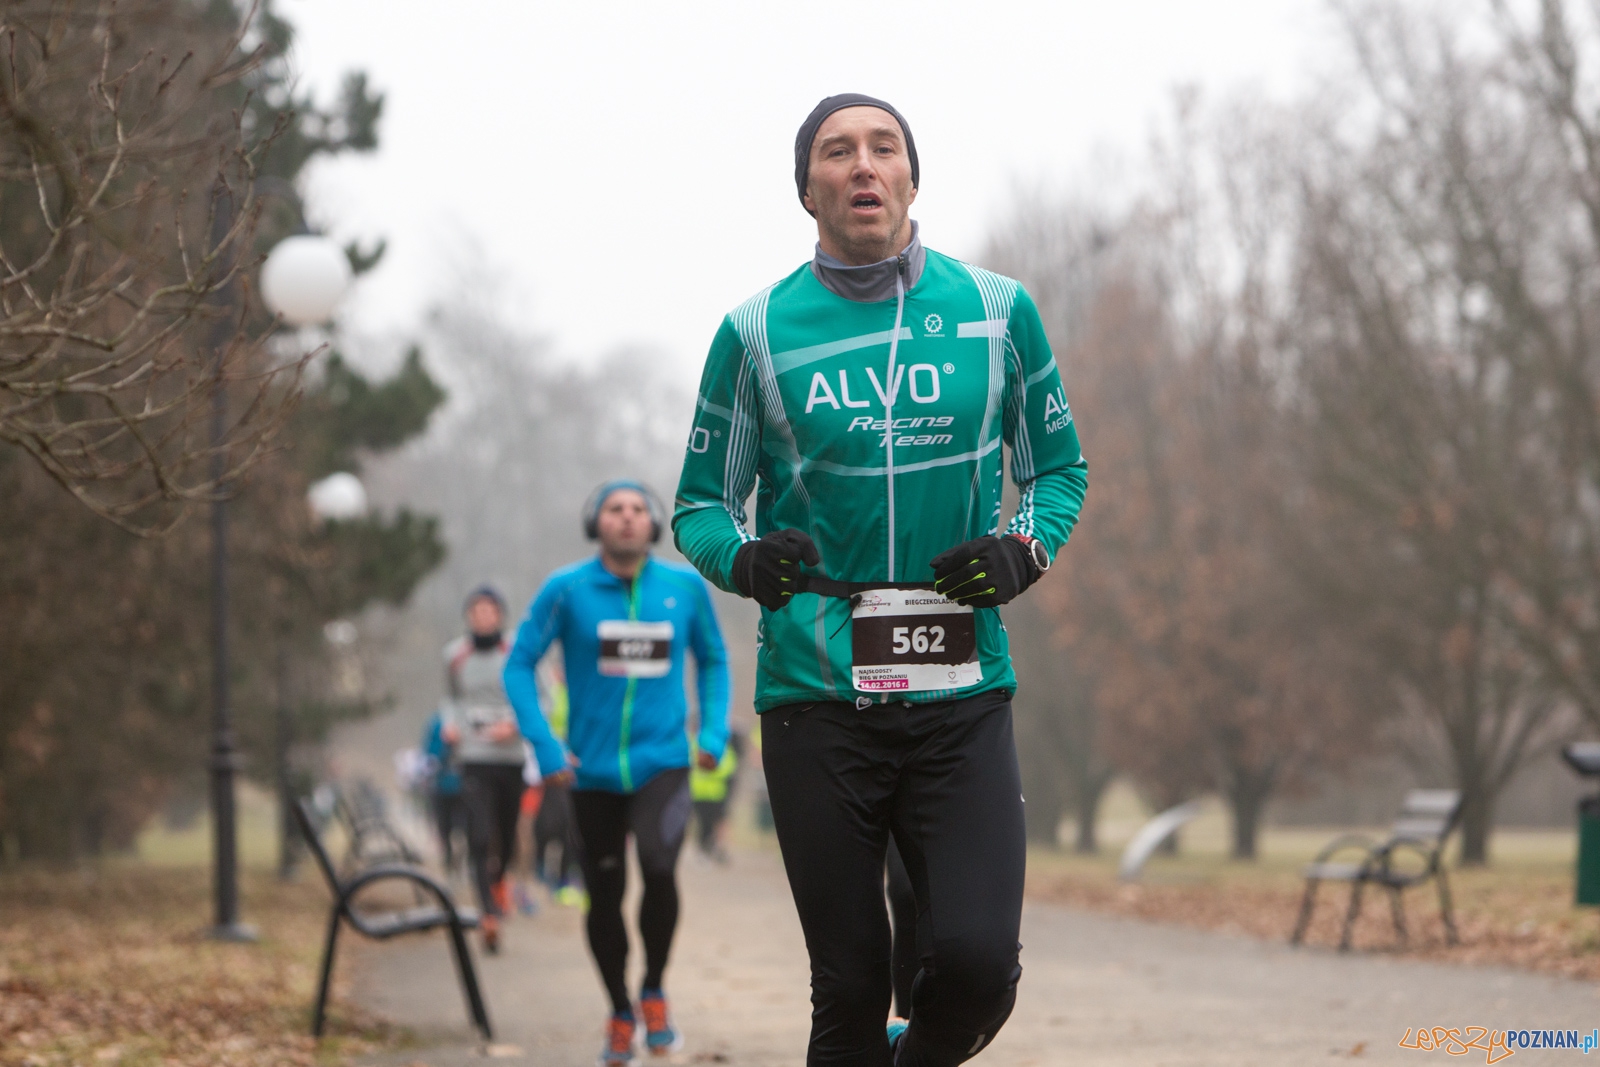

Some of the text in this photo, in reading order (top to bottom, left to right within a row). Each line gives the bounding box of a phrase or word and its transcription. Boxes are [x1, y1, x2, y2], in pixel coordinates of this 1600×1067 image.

[847, 416, 955, 432] Racing
[878, 432, 954, 447] Team
[905, 598, 959, 606] BIEGCZEKOLADO
[892, 625, 945, 654] 562
[860, 681, 900, 689] 14.02.2016
